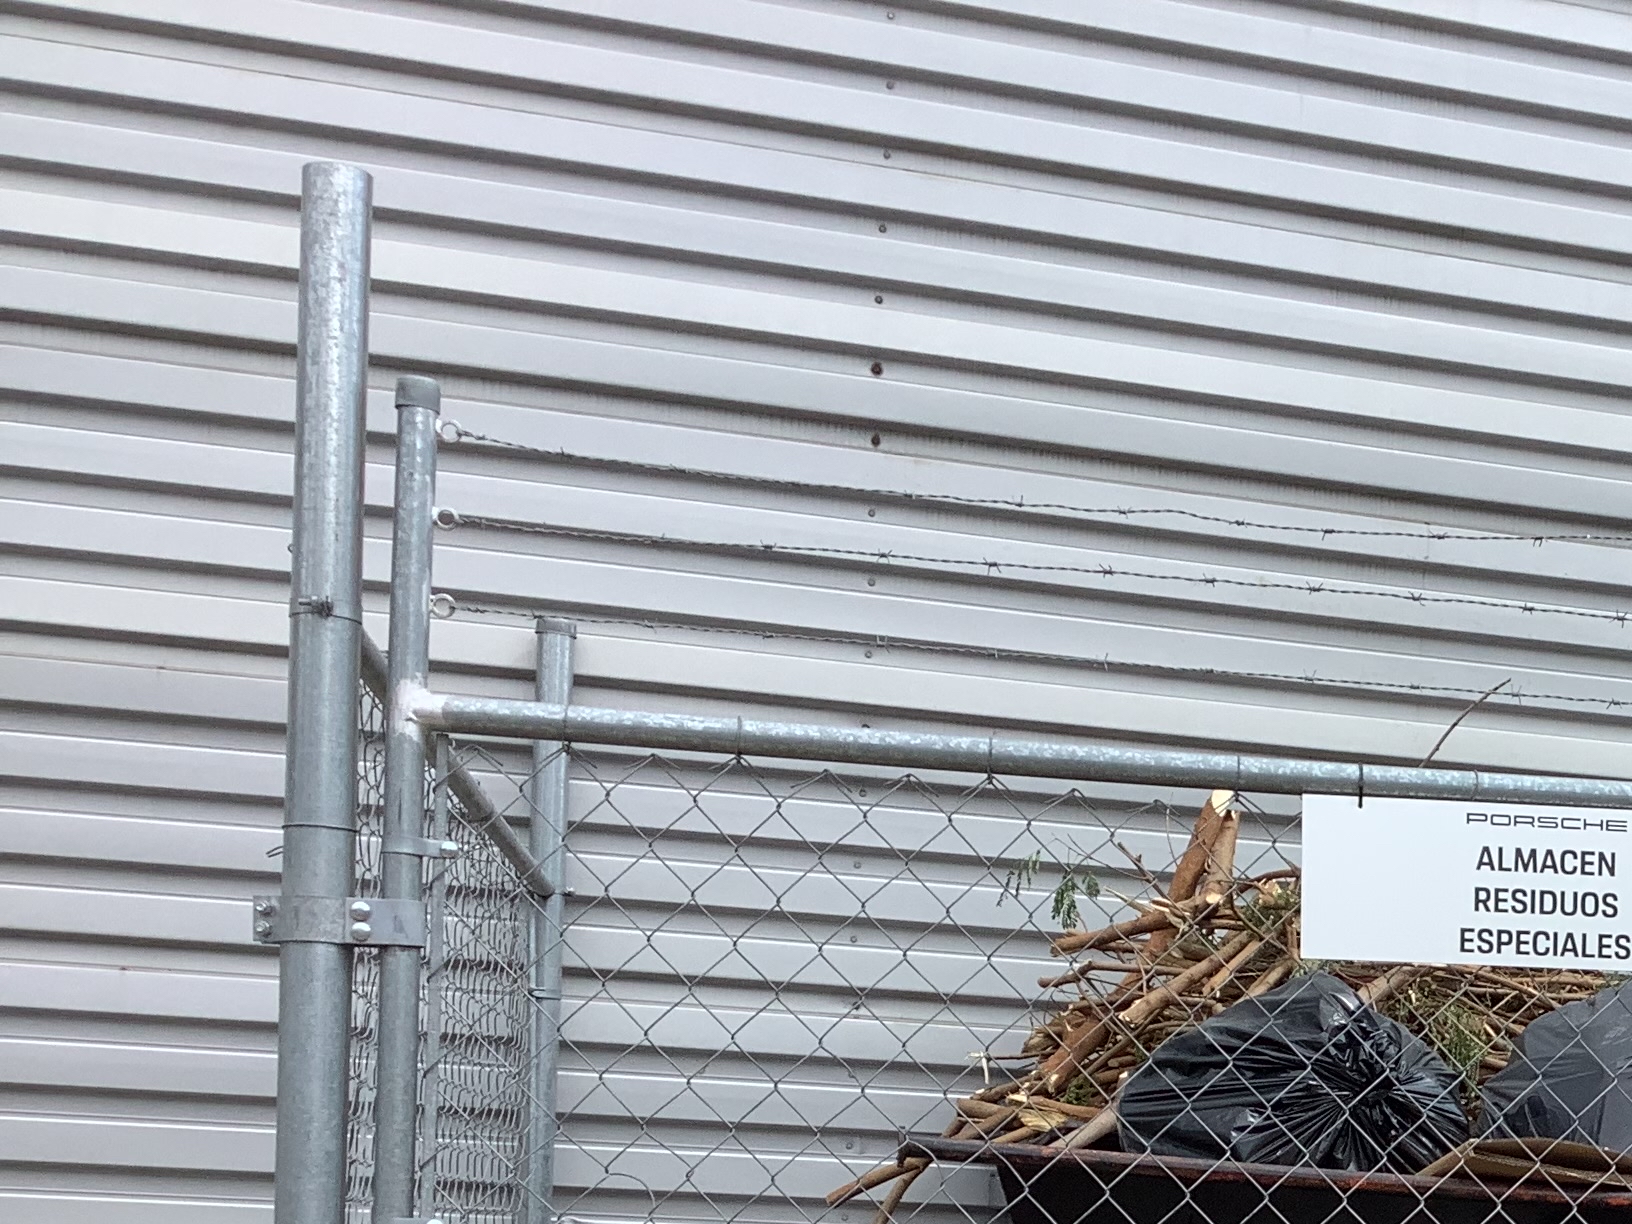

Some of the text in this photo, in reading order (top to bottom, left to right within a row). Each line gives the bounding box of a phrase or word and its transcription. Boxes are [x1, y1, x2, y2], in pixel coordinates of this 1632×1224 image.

[1466, 812, 1628, 832] PORSCHE
[1476, 846, 1616, 877] ALMACEN
[1474, 886, 1618, 918] RESIDUOS
[1459, 927, 1631, 960] ESPECIALES
